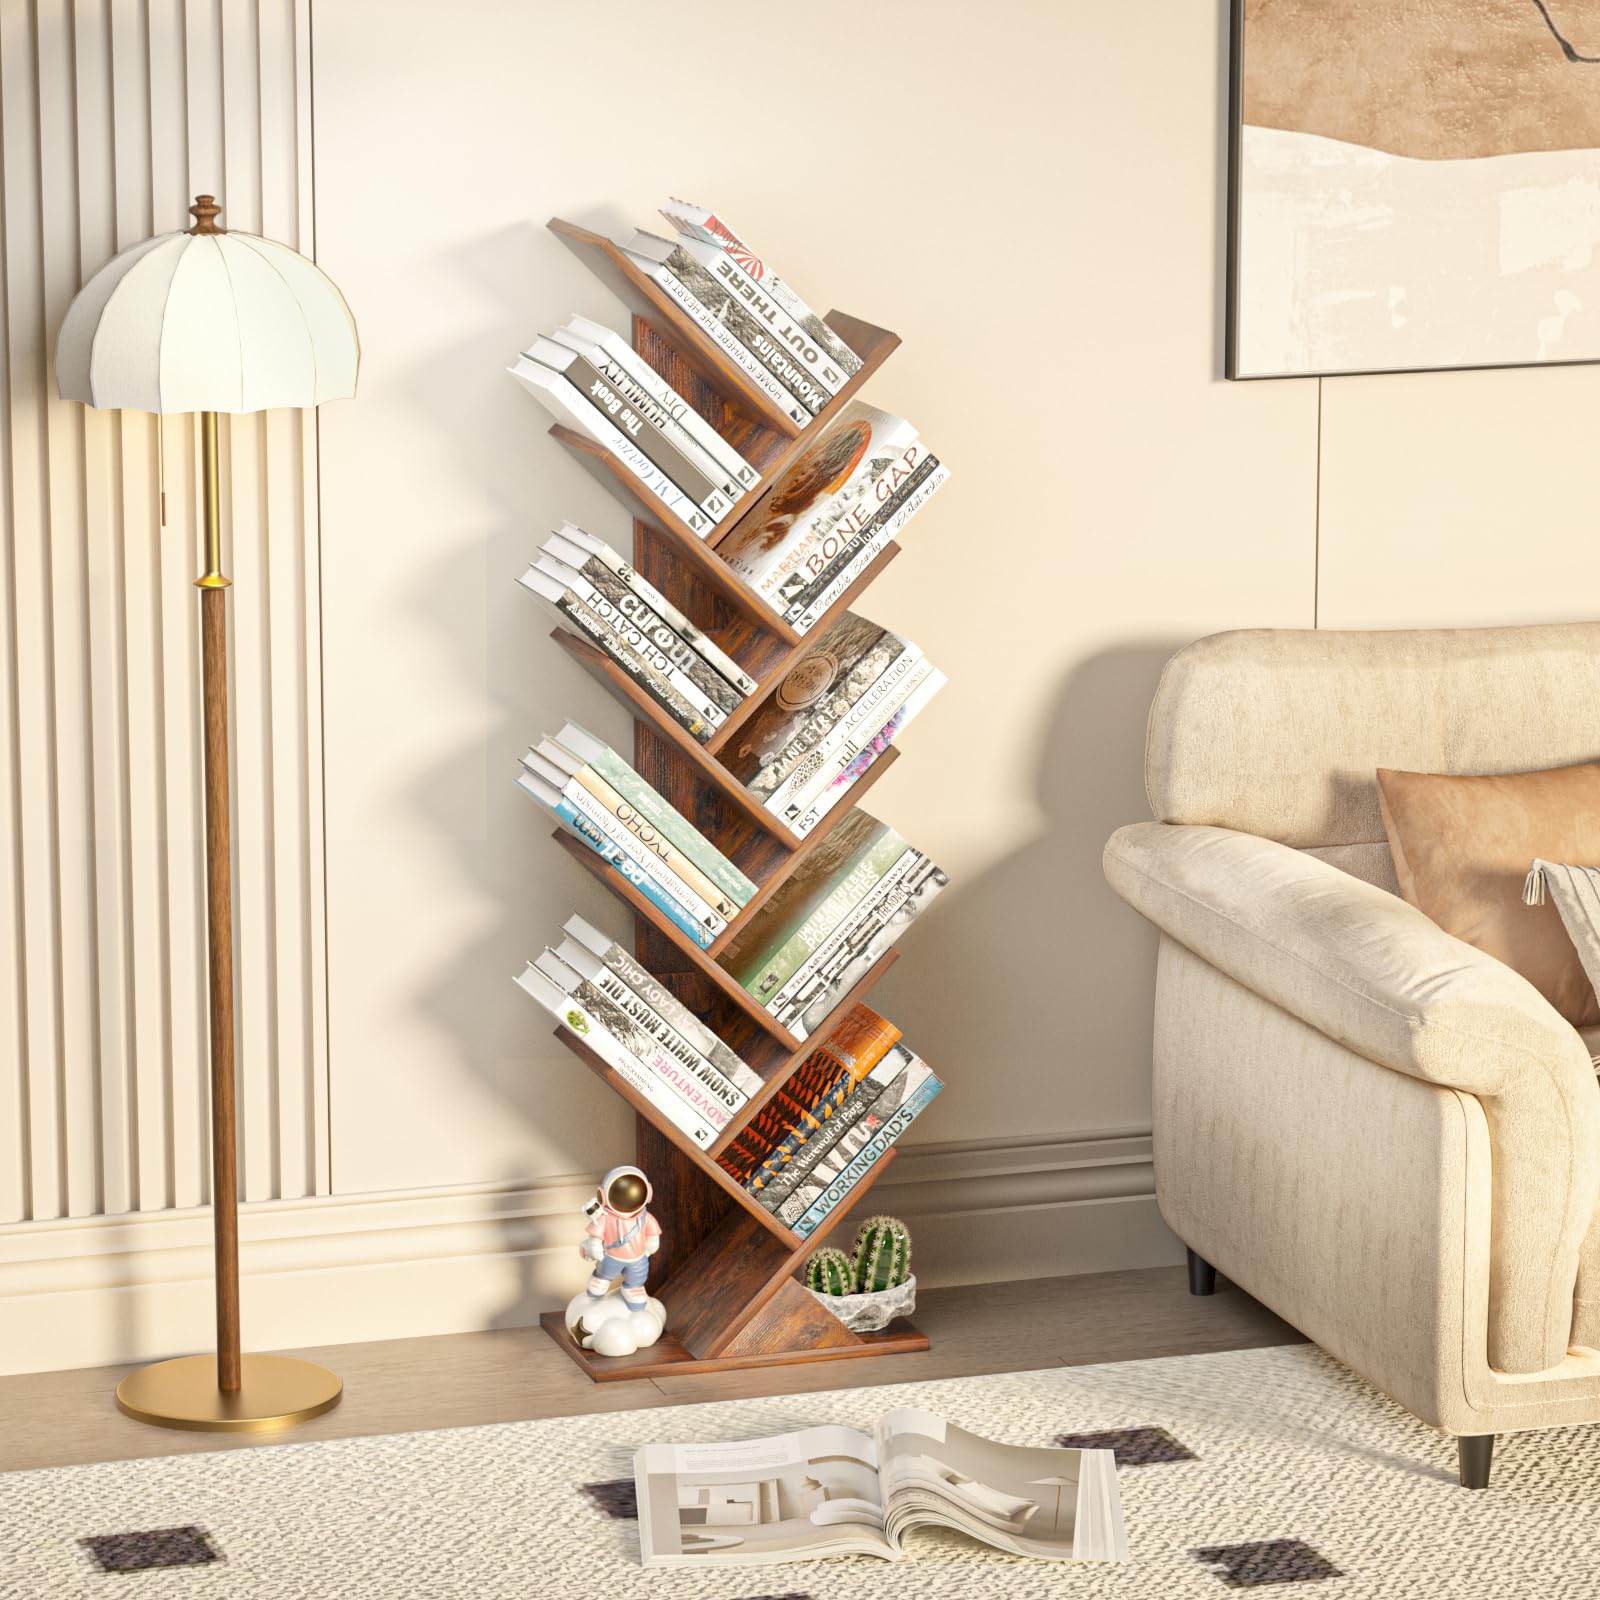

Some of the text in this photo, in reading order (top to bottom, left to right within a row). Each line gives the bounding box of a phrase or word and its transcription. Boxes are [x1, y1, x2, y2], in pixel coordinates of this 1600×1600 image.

[662, 273, 785, 400] HOME IS WHERE THE HEART IS
[716, 260, 820, 365] OUT THERE
[588, 378, 623, 414] Book
[598, 357, 671, 429] HUMILITY
[750, 333, 823, 411] Mountains
[617, 407, 645, 436] The
[656, 389, 689, 420] Dry
[612, 434, 655, 481] Coetzee
[651, 476, 671, 496] M.
[804, 444, 918, 576] BONE GAP
[616, 562, 637, 582] 32
[759, 529, 817, 593] MARTIAN
[848, 539, 880, 575] Beauty
[585, 591, 643, 648] CATCH
[844, 654, 913, 731] ACCELERATION
[772, 738, 807, 778] JANE
[803, 705, 838, 742] EYRE
[574, 789, 618, 835] Chemistry
[613, 800, 676, 862] TYCHO
[613, 830, 629, 844] of
[798, 806, 821, 831] FST
[599, 841, 648, 886] pearl
[625, 840, 649, 864] Year
[646, 860, 700, 912] International
[797, 861, 870, 940] UNIMAGINABLE
[805, 869, 879, 949] POSSIBILITIES
[875, 881, 910, 918] THE NOVELS
[789, 856, 911, 990] The Adventures of Tom Sawyer
[612, 955, 644, 985] CHIC
[640, 982, 675, 1015] LADY
[598, 974, 741, 1107] SNOW WHITE MUST DIE
[617, 1057, 655, 1092] PROGRAMMING
[617, 1067, 643, 1091] INTERFACE
[651, 1054, 727, 1126] ADVENTURE
[780, 1099, 863, 1186] The Werewolf of Paris
[814, 1107, 914, 1214] WORKING DAD'S
